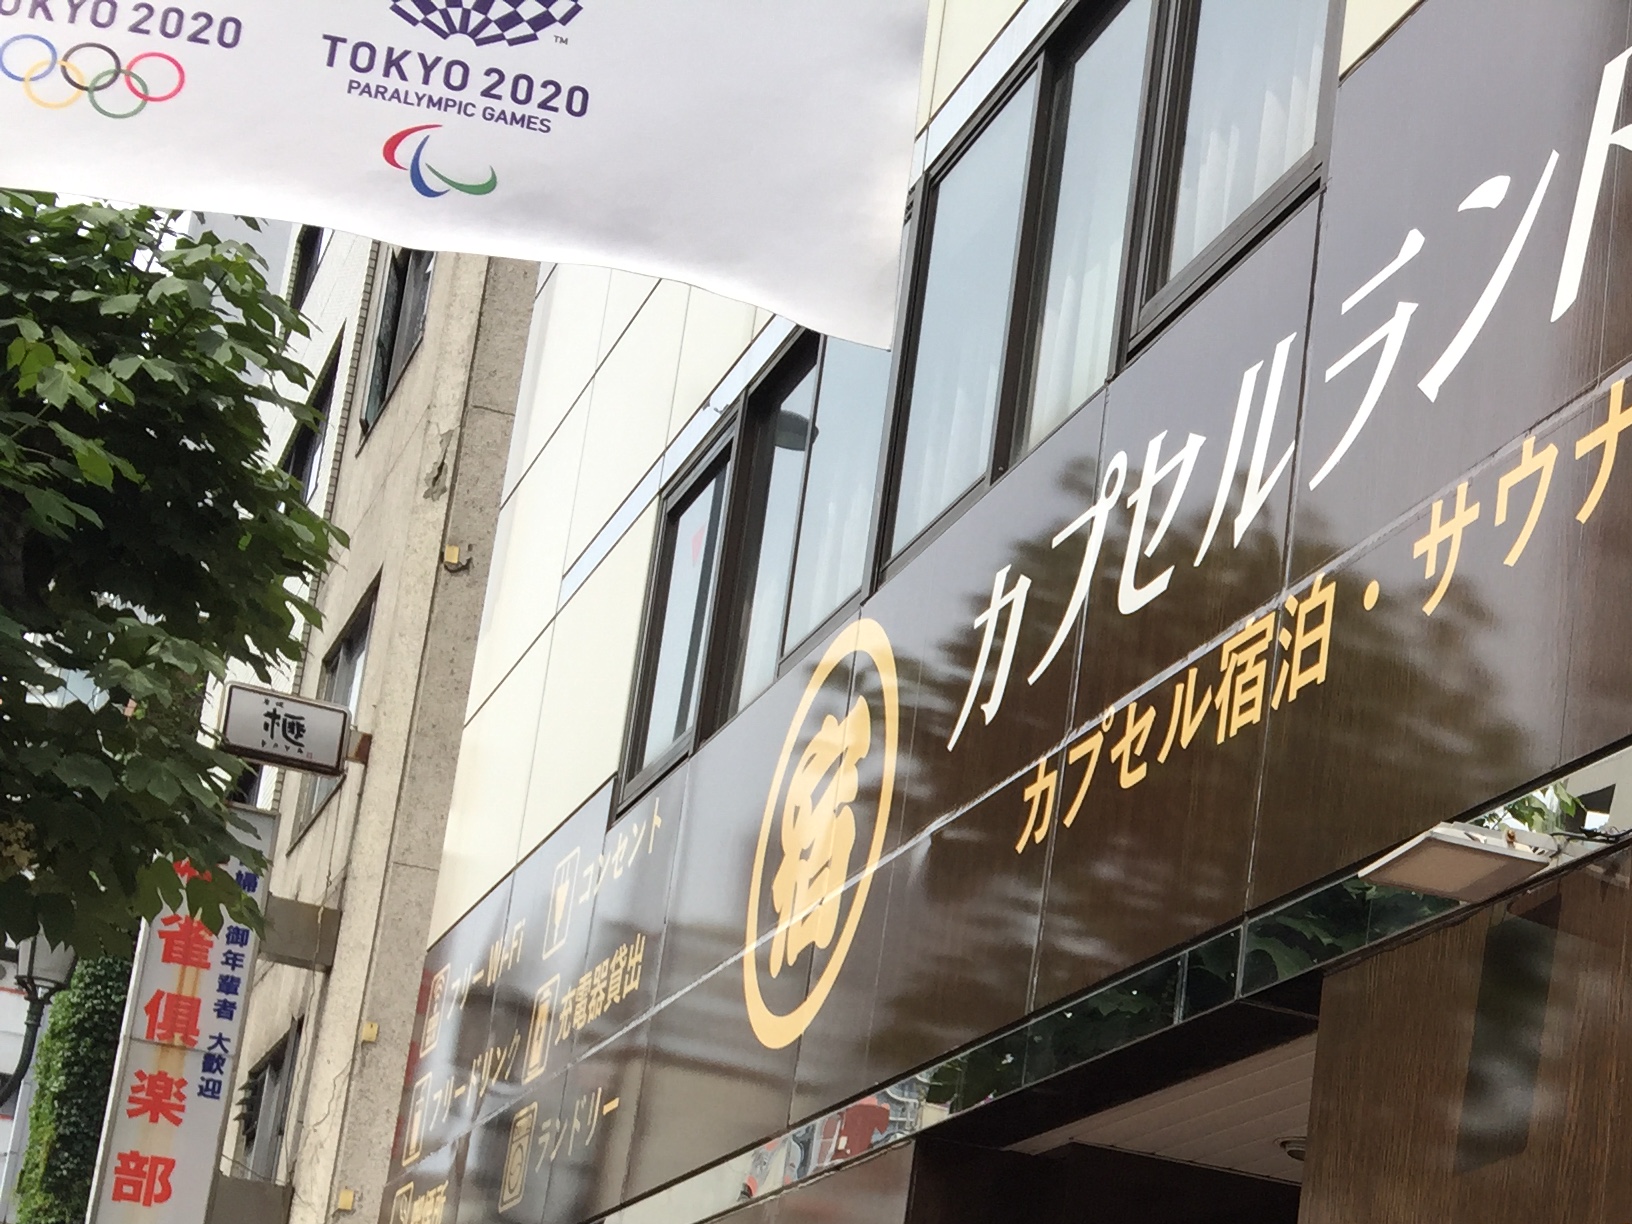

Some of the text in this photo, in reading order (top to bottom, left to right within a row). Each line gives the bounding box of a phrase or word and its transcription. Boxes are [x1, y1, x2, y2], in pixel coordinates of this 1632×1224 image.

[0, 0, 243, 49] KYO 2020
[322, 33, 590, 118] TOKYO 2020
[347, 79, 552, 134] PARALYMPIC GAMES
[579, 797, 663, 906] コンセント
[111, 856, 218, 1208] 雀倶楽部
[553, 932, 648, 1048] 充電器貸出
[427, 1026, 522, 1133] フリードリンク
[535, 1087, 622, 1175] ランドリー
